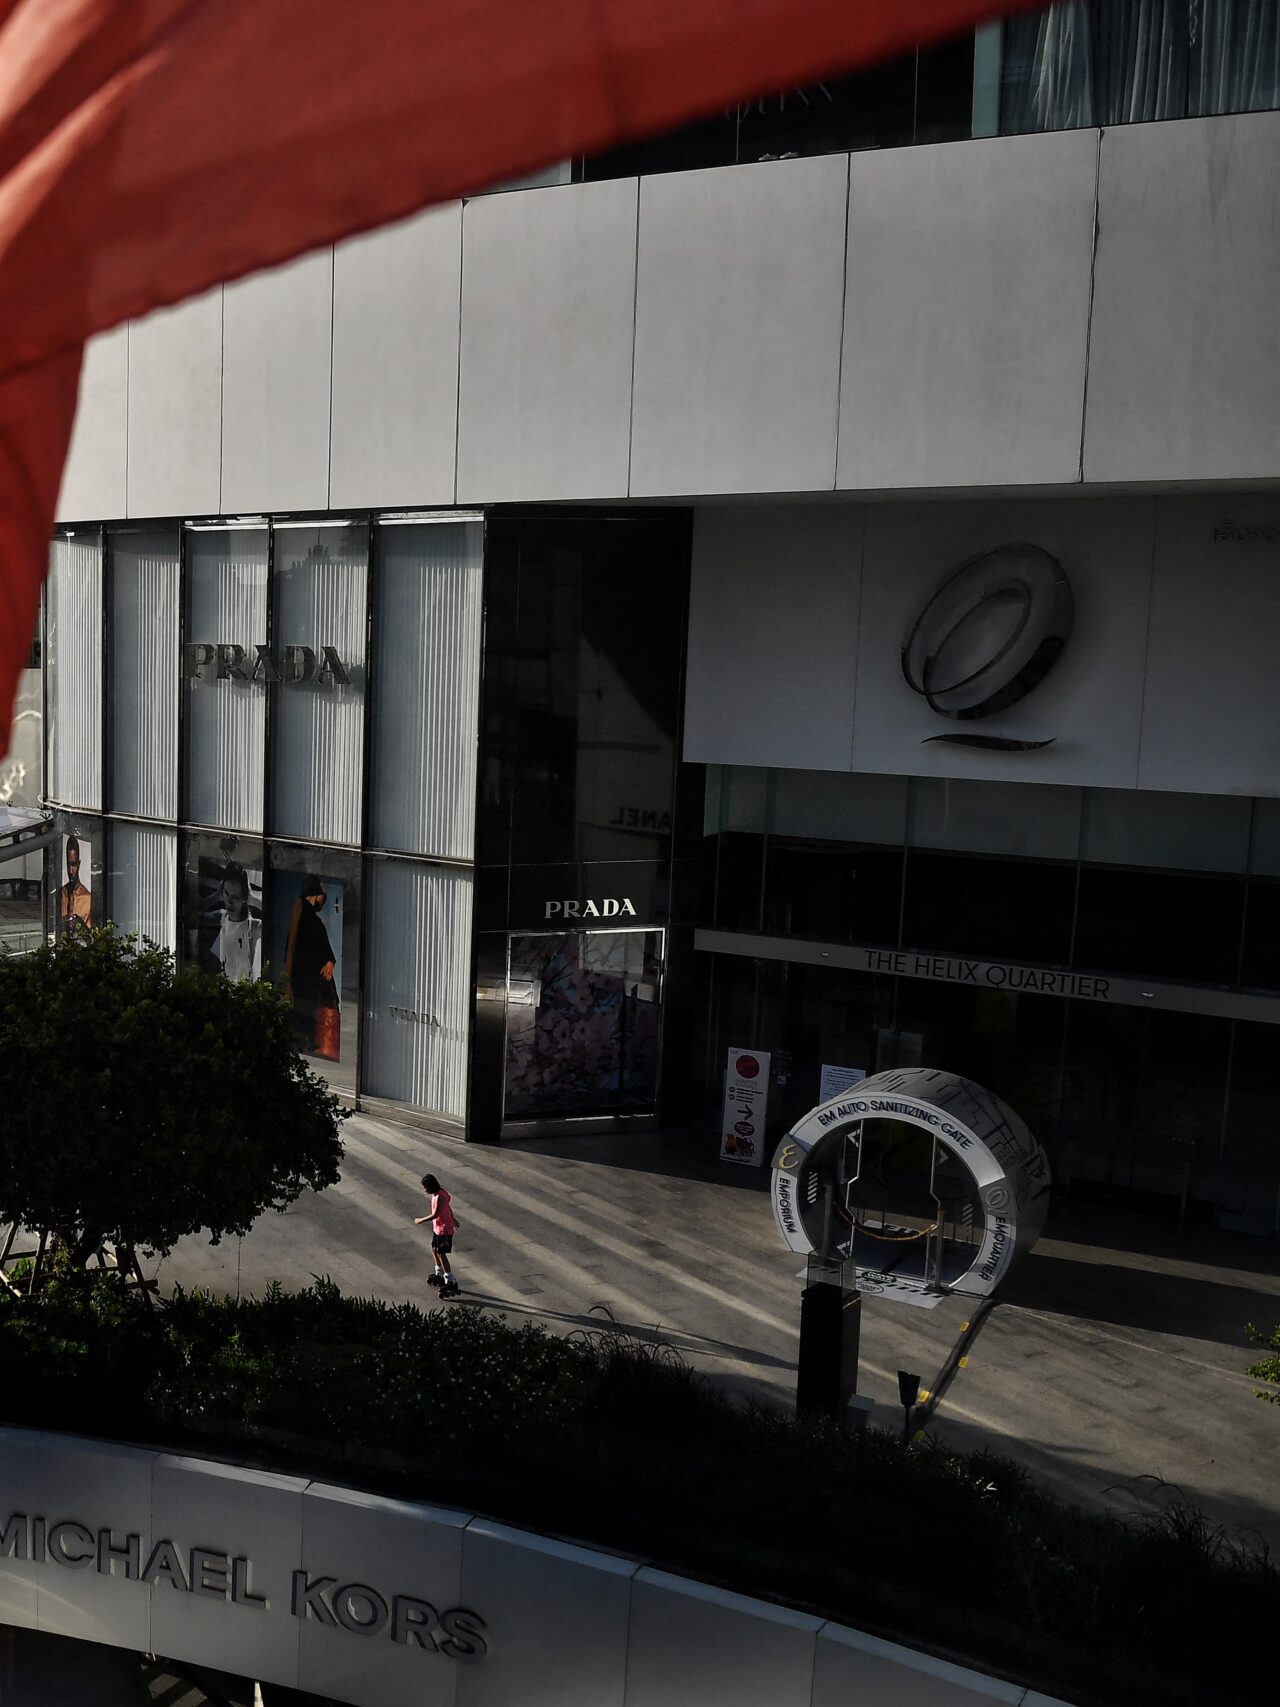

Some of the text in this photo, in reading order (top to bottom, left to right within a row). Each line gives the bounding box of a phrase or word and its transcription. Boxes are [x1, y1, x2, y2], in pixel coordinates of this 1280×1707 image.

[184, 642, 351, 685] PRADA
[544, 898, 638, 919] PRADA
[864, 950, 1110, 999] THE HELIX QUARTIER
[817, 1100, 974, 1151] EM AUTO SANITIZING GATE
[778, 1176, 797, 1234] EMPORIUM
[290, 1569, 488, 1663] KORS
